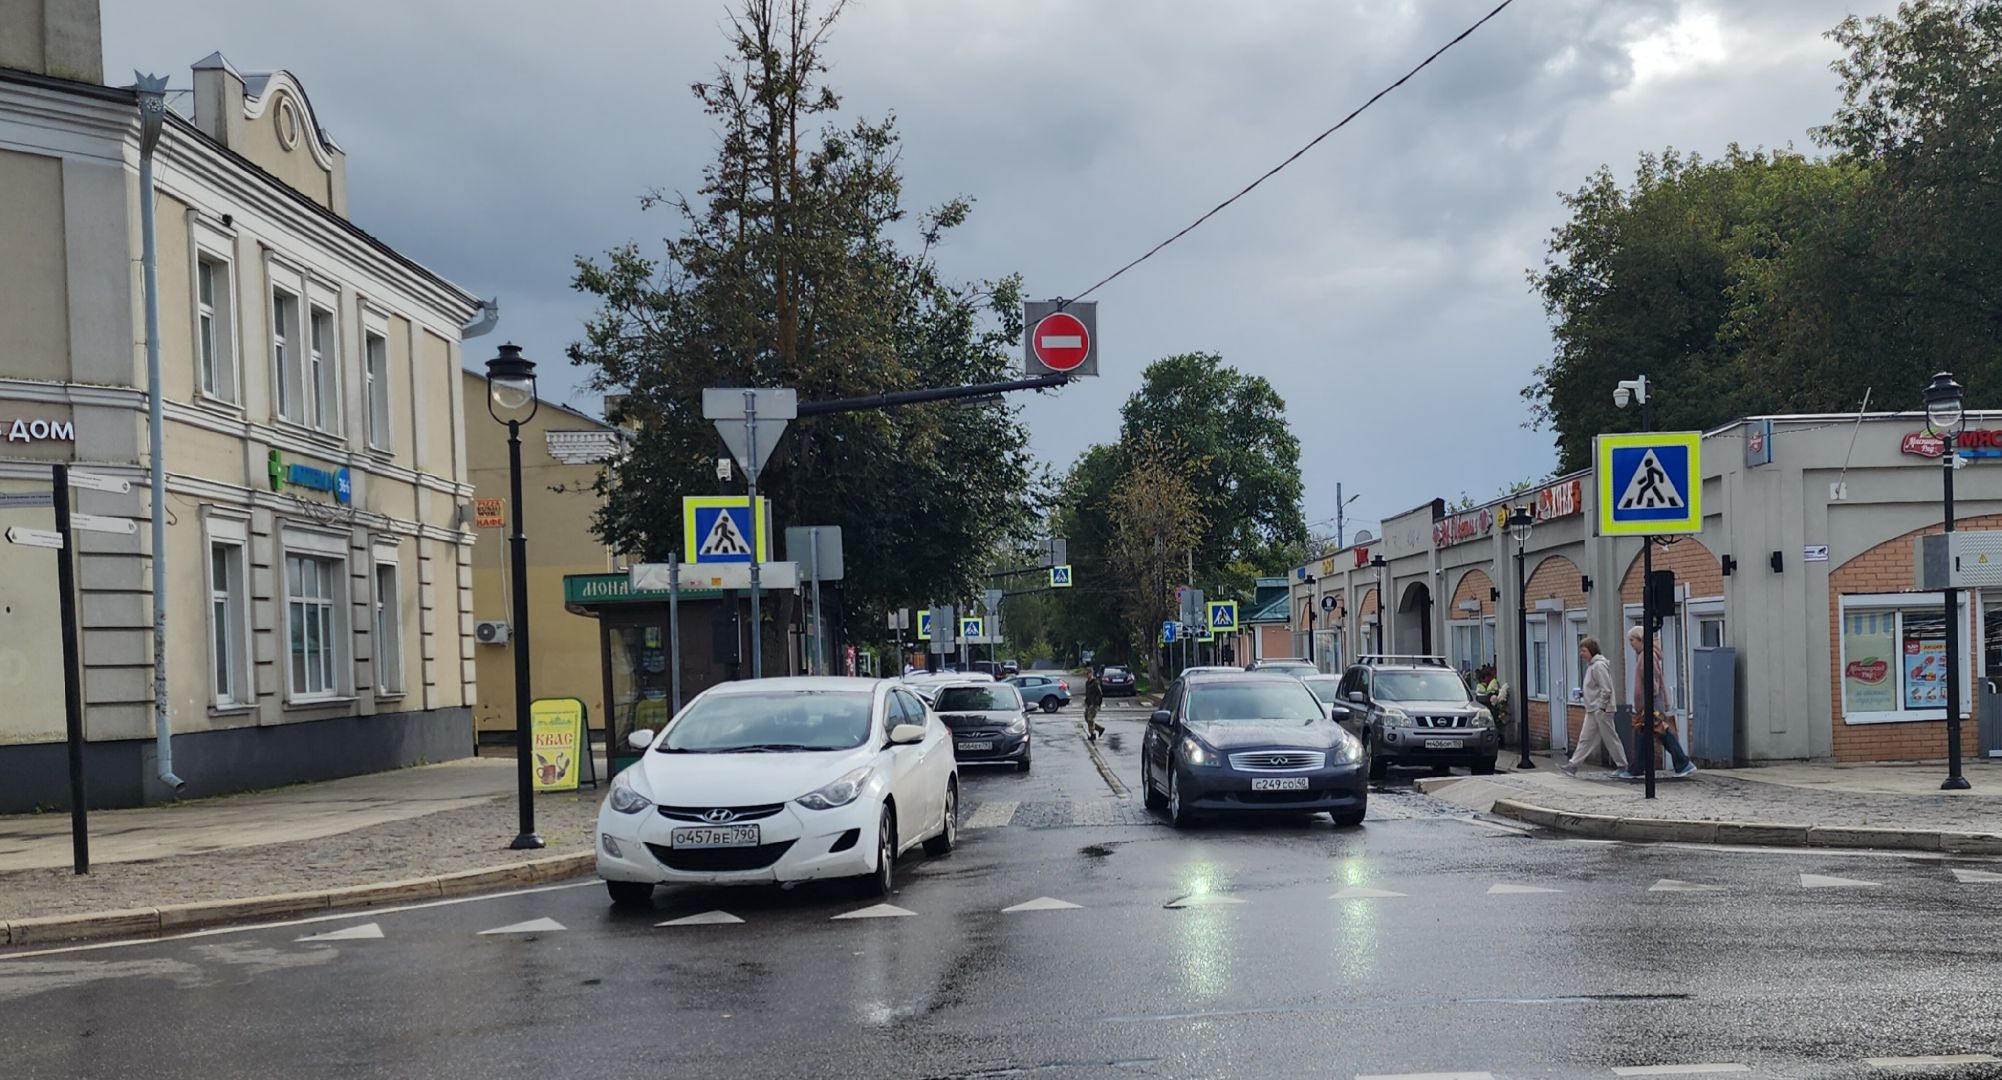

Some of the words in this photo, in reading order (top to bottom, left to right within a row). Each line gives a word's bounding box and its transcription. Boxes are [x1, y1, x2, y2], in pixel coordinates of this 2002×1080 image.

[8, 418, 75, 443] ДОМ
[477, 518, 503, 527] КАФЕ
[536, 733, 573, 746] КВАС
[676, 830, 730, 844] О457ВЕ
[734, 829, 755, 840] 790
